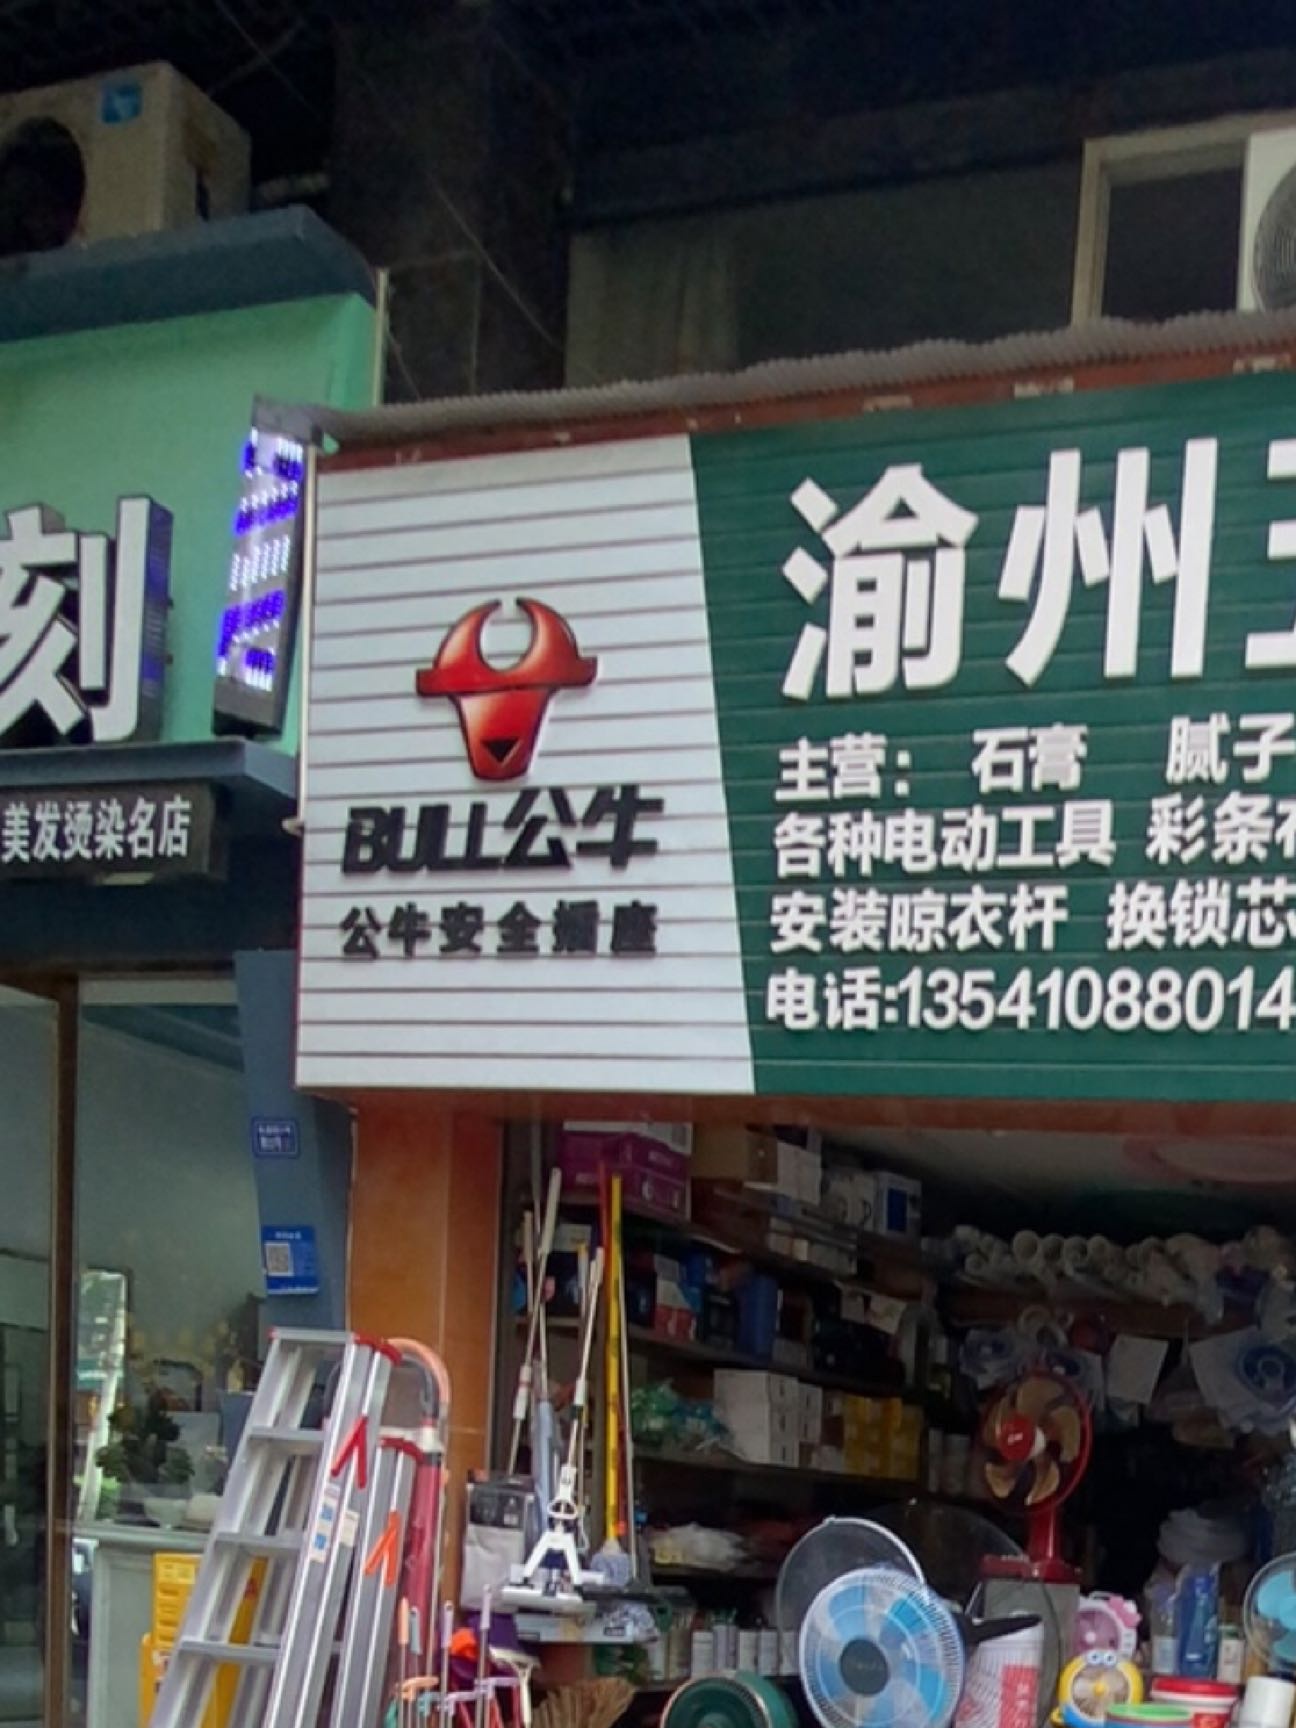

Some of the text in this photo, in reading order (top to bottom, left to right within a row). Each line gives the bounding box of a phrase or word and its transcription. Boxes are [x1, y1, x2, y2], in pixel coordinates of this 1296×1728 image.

[973, 723, 1087, 791] 石膏
[2, 793, 192, 863] 美发烫染名店
[341, 784, 664, 876] BULL公牛
[773, 802, 1115, 877] 各种电动工具
[340, 899, 658, 960] 公牛安全插座
[768, 884, 1069, 953] 安装晾衣杆
